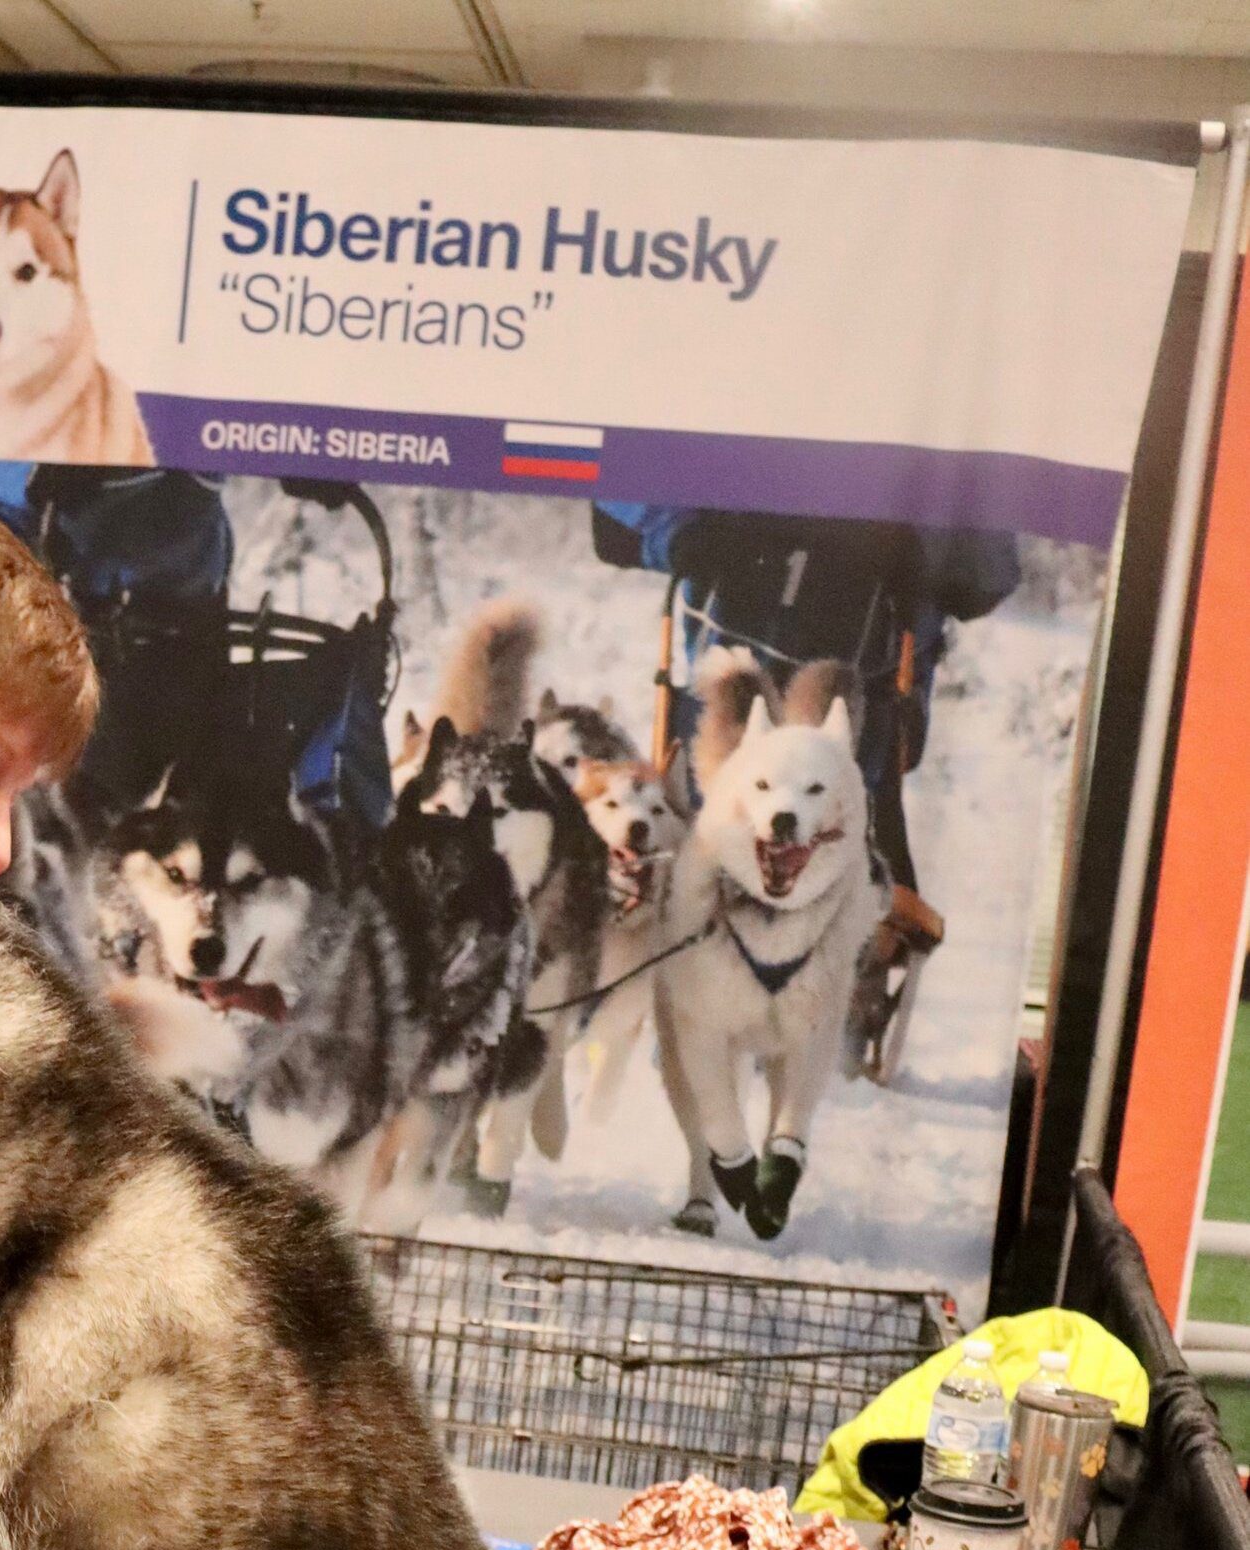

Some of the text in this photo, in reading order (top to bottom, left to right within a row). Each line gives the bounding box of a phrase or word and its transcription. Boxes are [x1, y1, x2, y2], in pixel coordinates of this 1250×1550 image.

[221, 188, 779, 301] Siberian Husky
[201, 419, 450, 466] ORIGIN: SIBERIA
